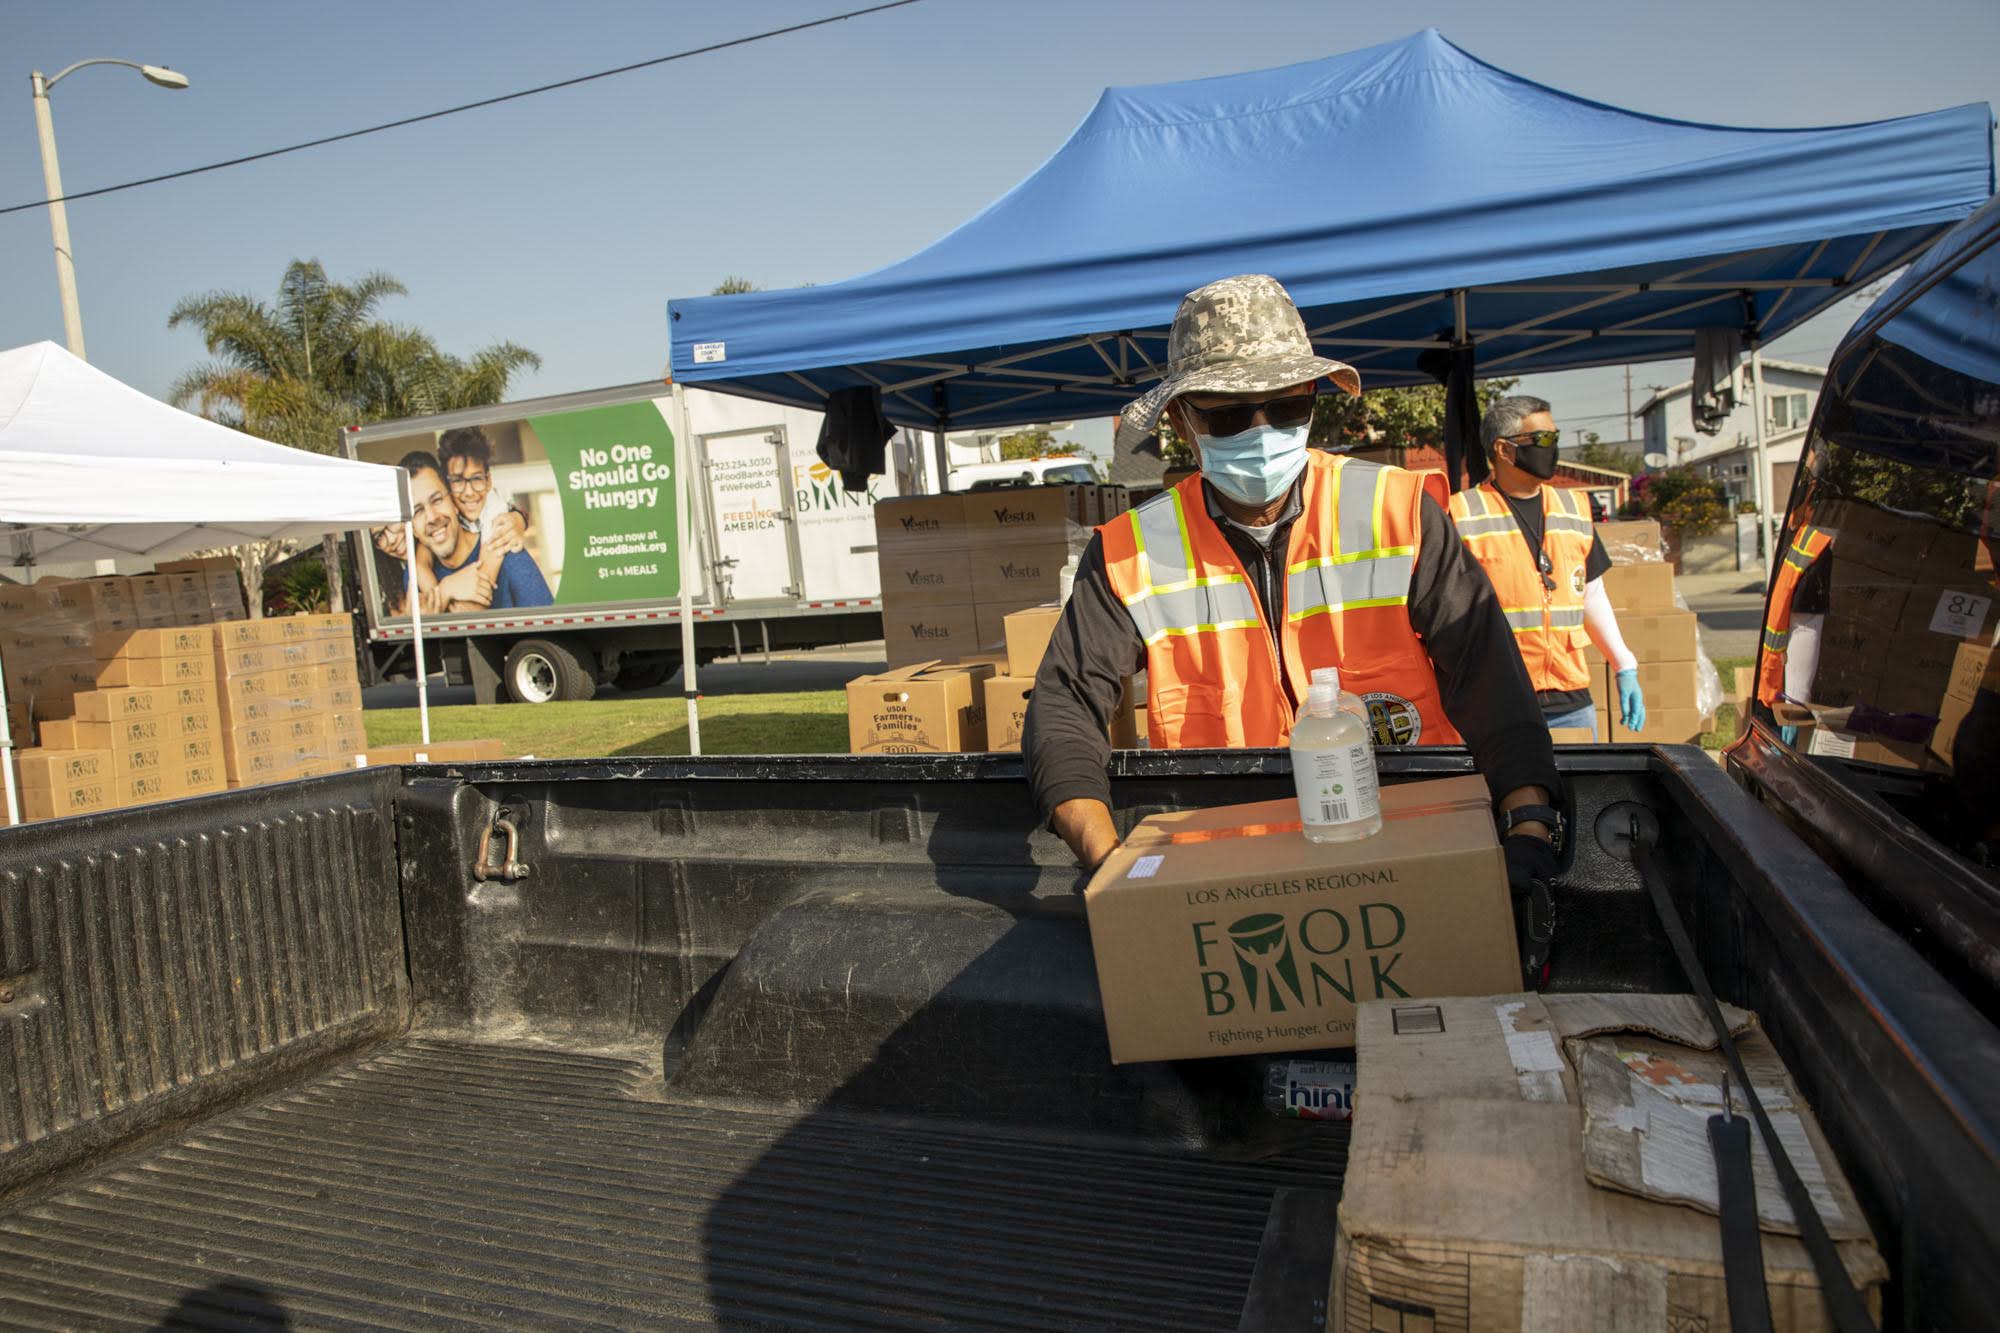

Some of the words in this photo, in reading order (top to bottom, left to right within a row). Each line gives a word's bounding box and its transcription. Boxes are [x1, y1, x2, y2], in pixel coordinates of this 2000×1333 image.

[580, 448, 608, 468] No
[611, 444, 652, 464] One
[568, 463, 639, 490] Should
[642, 462, 670, 481] Go
[584, 487, 658, 509] Hungry
[901, 514, 940, 533] Vesta
[994, 506, 1036, 525] Vesta
[724, 520, 775, 532] AMERICA
[589, 534, 624, 545] Donate
[625, 532, 646, 542] now
[647, 530, 658, 539] at
[583, 542, 667, 558] LAFoodBank.org
[616, 566, 623, 576] 4
[624, 564, 658, 576] MEALS
[906, 569, 945, 586] Vesta
[1000, 562, 1040, 580] Vesta
[910, 622, 950, 639] Vesta
[873, 712, 913, 723] Farmers
[876, 720, 918, 731] Families
[1186, 888, 1219, 905] LOS
[1224, 879, 1301, 902] ANGELES
[1306, 869, 1399, 893] REGIONAL
[1192, 902, 1406, 967] FOOD
[1201, 952, 1413, 1016] BANK
[1208, 1025, 1264, 1046] Fighting
[1267, 1023, 1321, 1041] Hunger.
[1326, 1018, 1356, 1034] Givi
